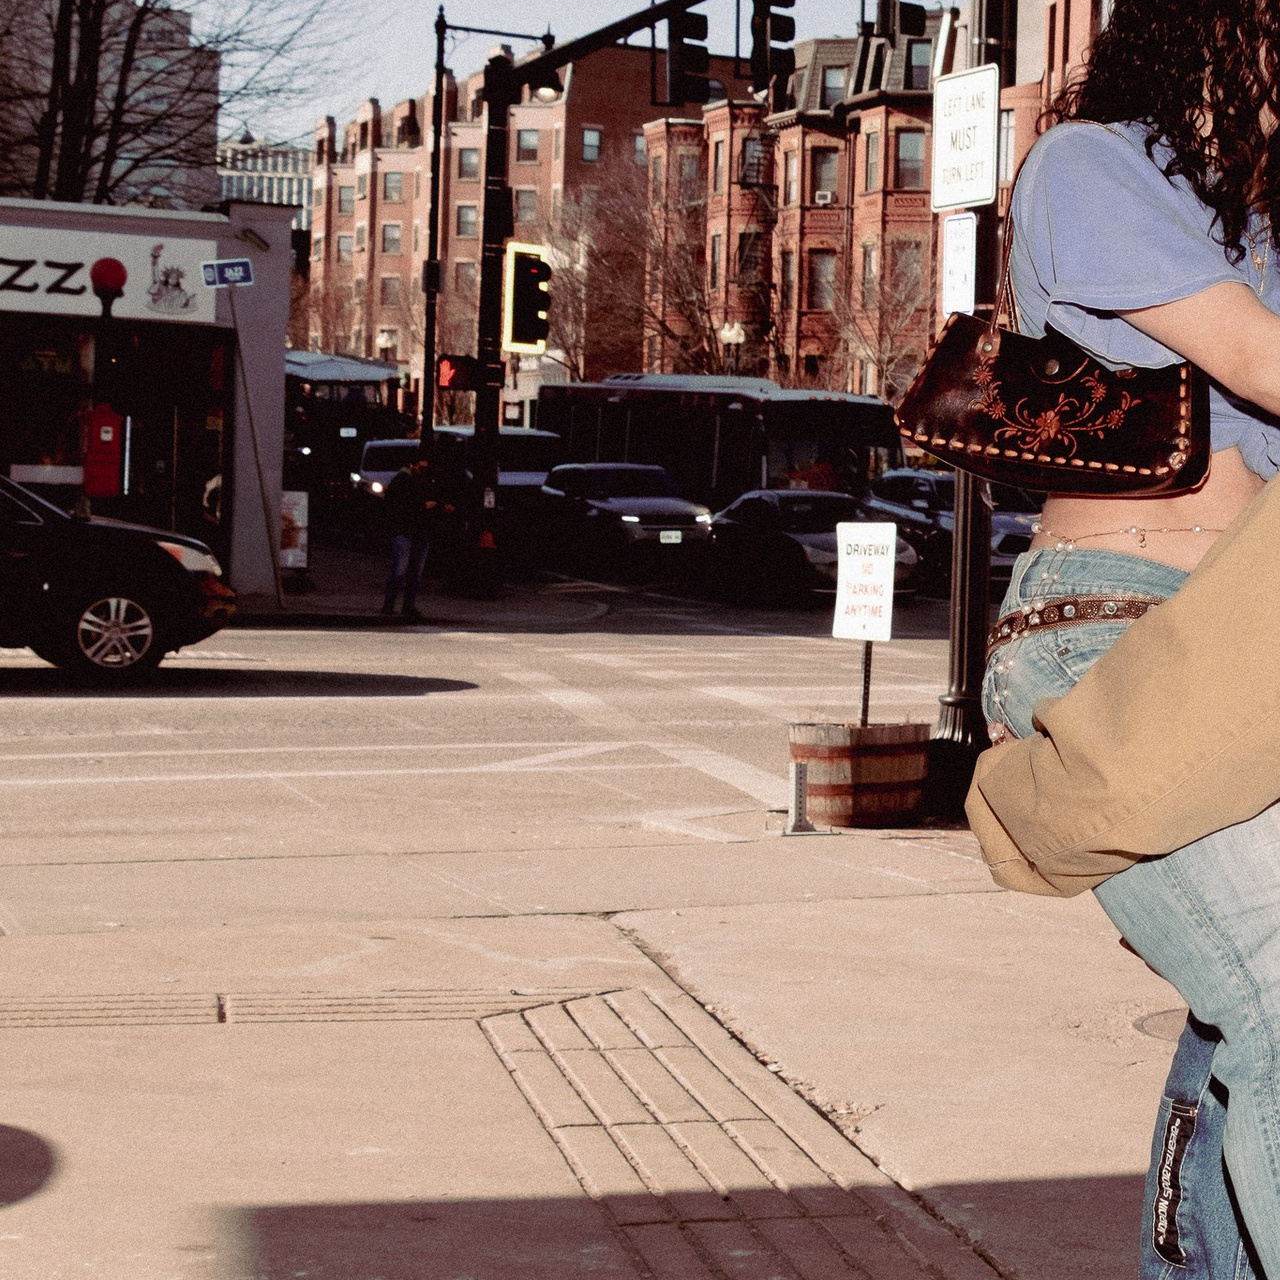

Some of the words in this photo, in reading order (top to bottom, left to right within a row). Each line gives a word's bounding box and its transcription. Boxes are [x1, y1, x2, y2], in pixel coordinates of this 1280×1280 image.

[943, 97, 962, 117] LEFT
[966, 91, 986, 112] LANE
[950, 125, 978, 151] MUST
[943, 166, 962, 185] TURN
[965, 161, 985, 181] LEFT
[846, 543, 890, 556] DRIVEWAY
[862, 563, 873, 575] NO
[846, 581, 884, 597] PARKING
[845, 604, 883, 618] ANYTIME
